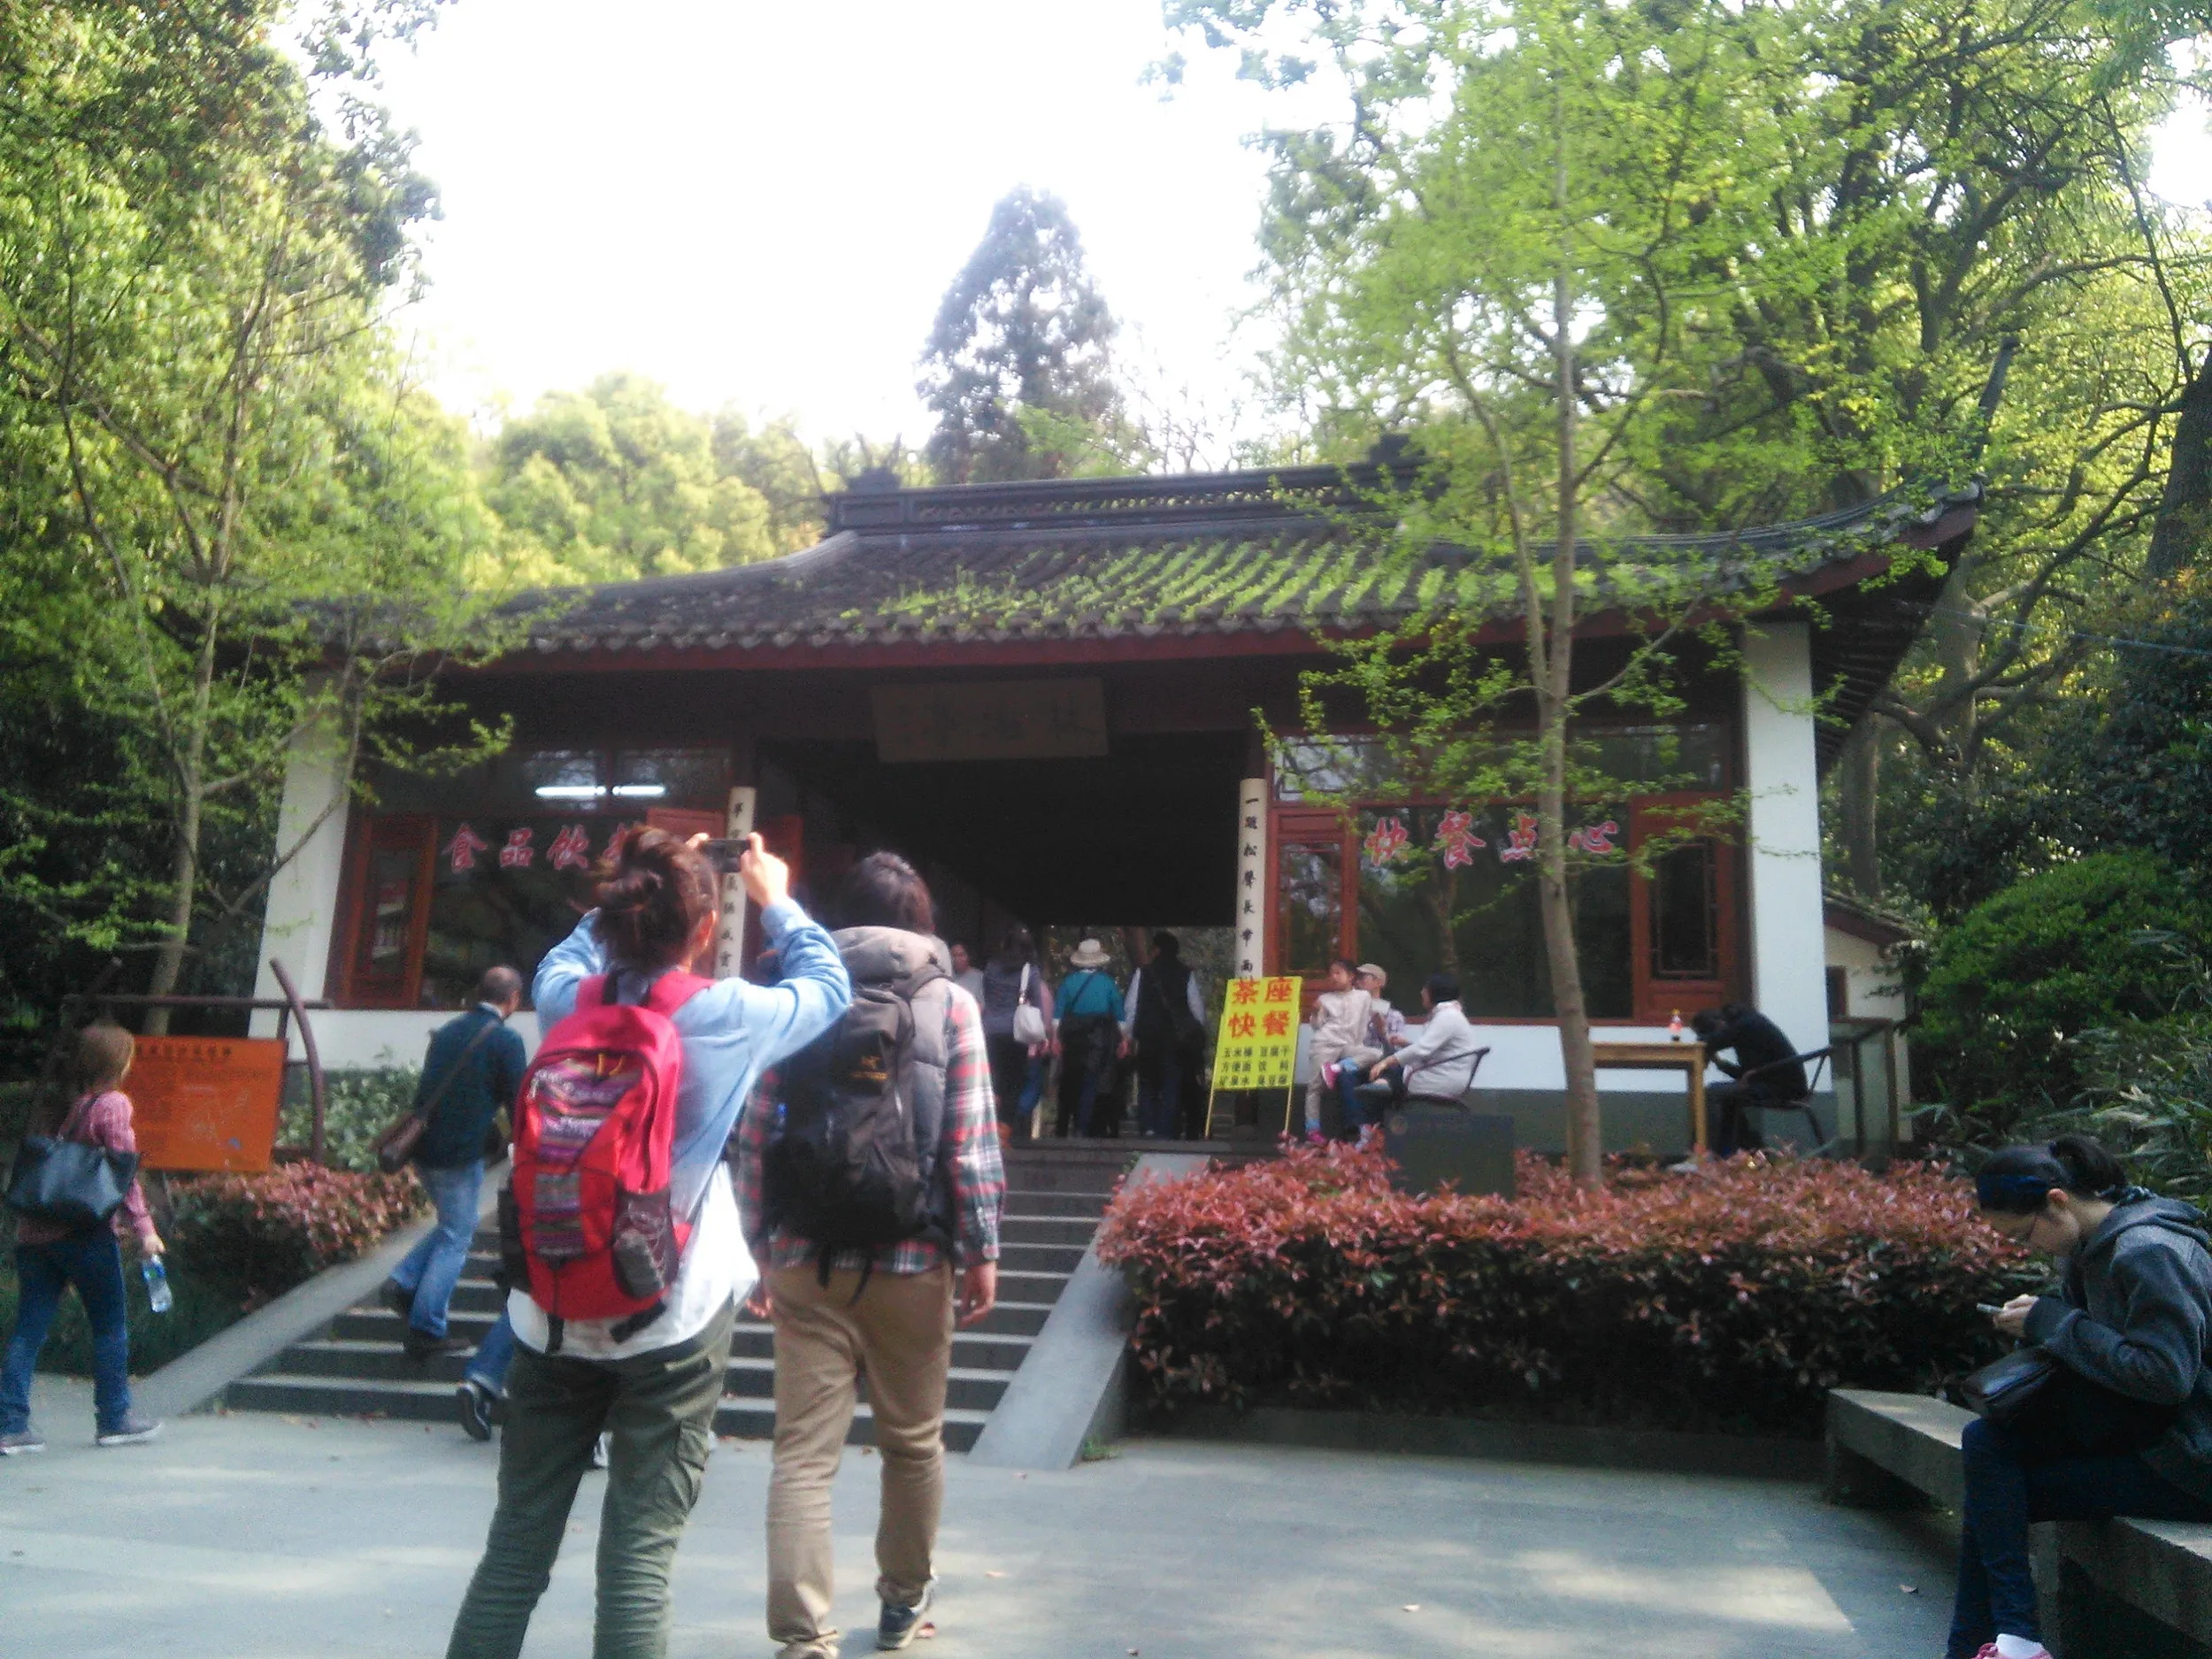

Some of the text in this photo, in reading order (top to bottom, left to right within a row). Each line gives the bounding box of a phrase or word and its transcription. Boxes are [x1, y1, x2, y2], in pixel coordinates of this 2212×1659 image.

[1364, 810, 1620, 870] 快餐点心
[1233, 976, 1293, 1004] 茶座
[1228, 1010, 1289, 1039] 快餐
